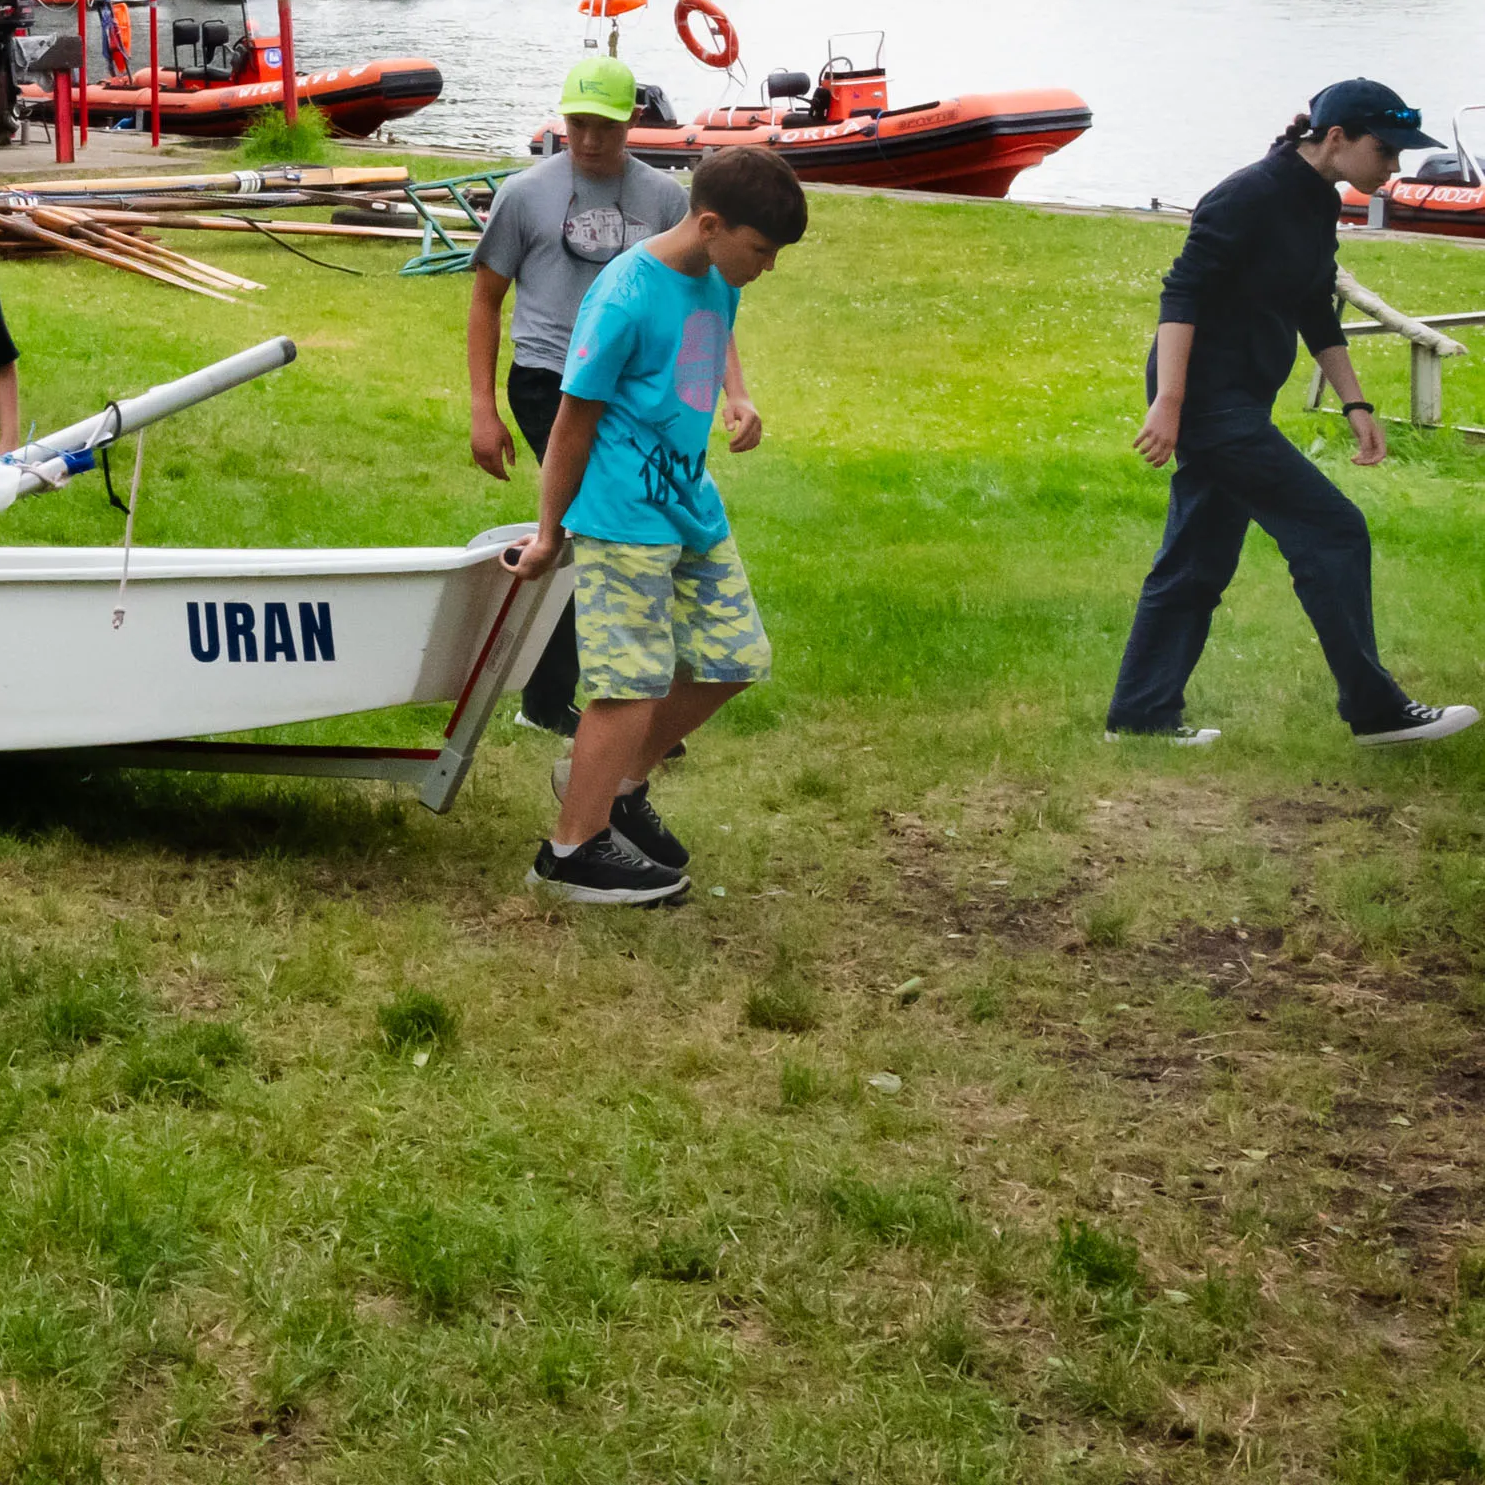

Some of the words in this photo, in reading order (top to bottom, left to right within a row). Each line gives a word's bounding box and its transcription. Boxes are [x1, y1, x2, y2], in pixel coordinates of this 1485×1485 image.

[239, 71, 339, 98] WIELRYB
[781, 121, 862, 143] ORKA
[1393, 185, 1412, 199] PL
[187, 602, 336, 663] URAN
